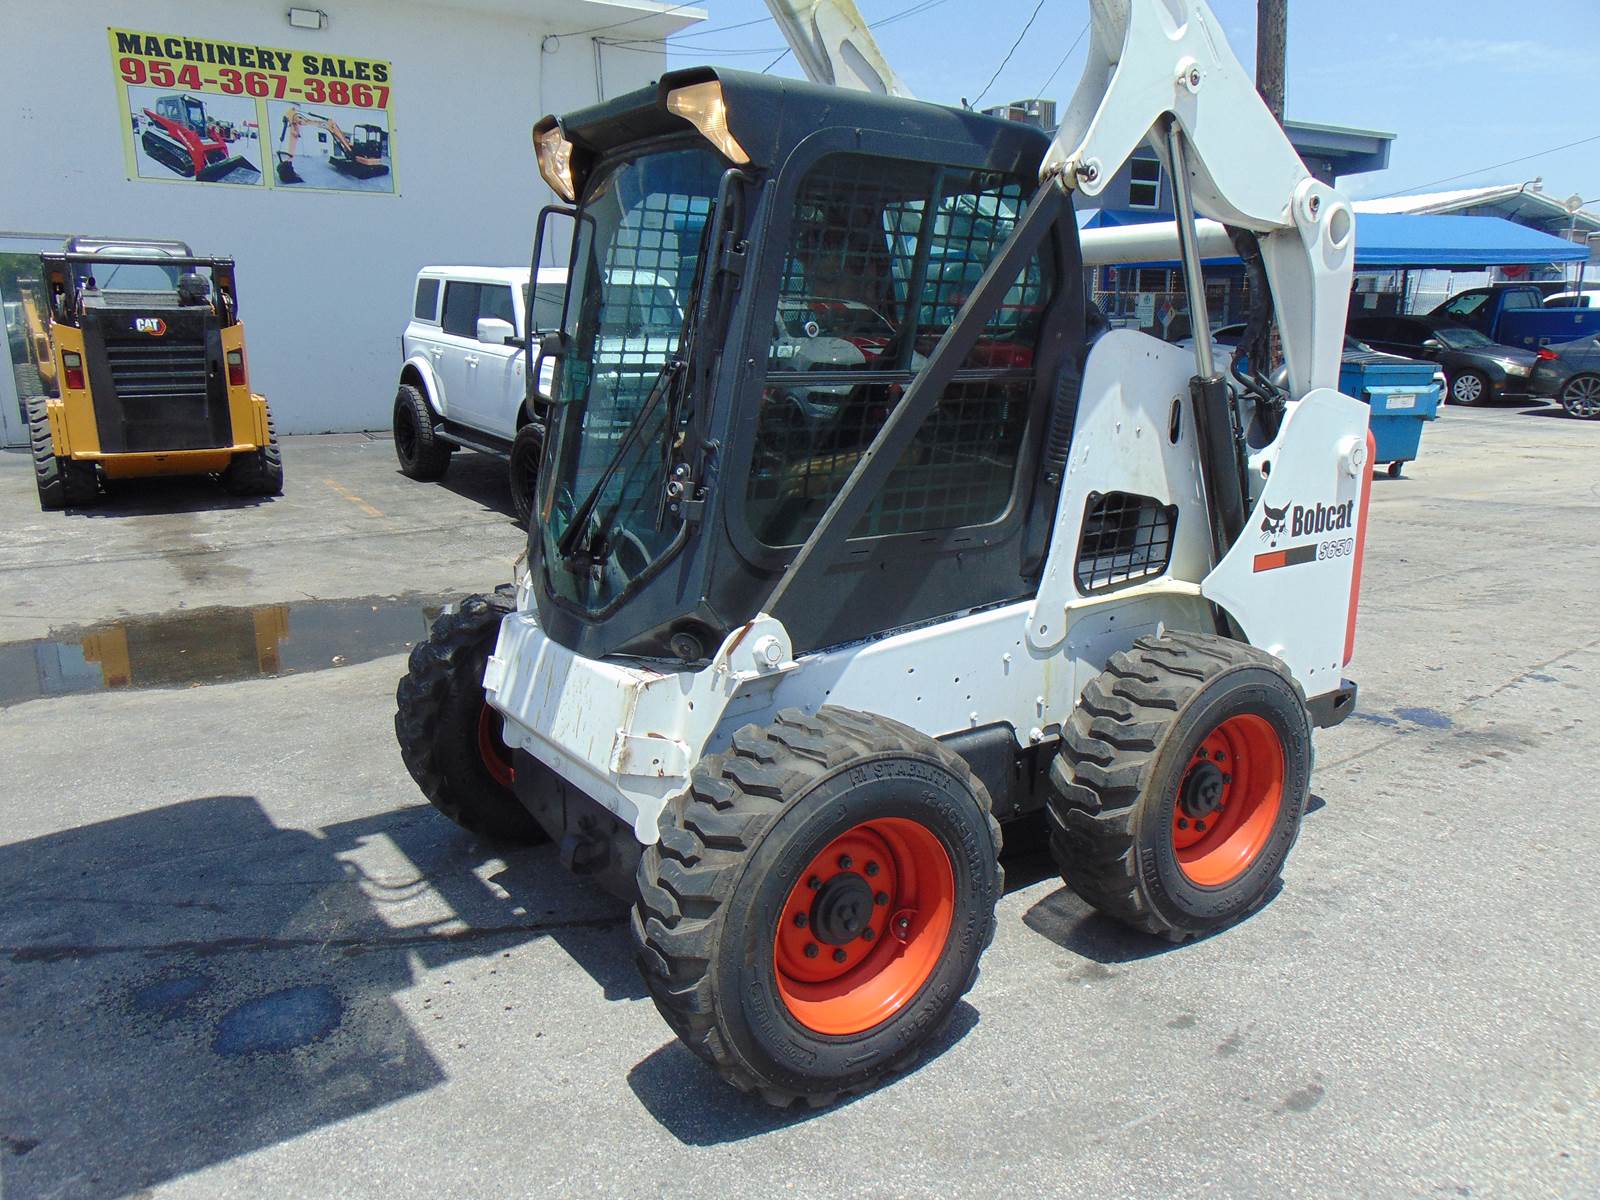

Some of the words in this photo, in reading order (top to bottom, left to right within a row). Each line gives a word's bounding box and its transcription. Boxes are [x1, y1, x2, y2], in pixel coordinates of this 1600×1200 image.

[115, 32, 292, 72] MACHINERY
[302, 55, 388, 82] SALES
[119, 58, 390, 108] 954-367-3867
[136, 318, 158, 332] CAT
[1291, 500, 1354, 538] Bobcat
[1318, 537, 1354, 561] S650
